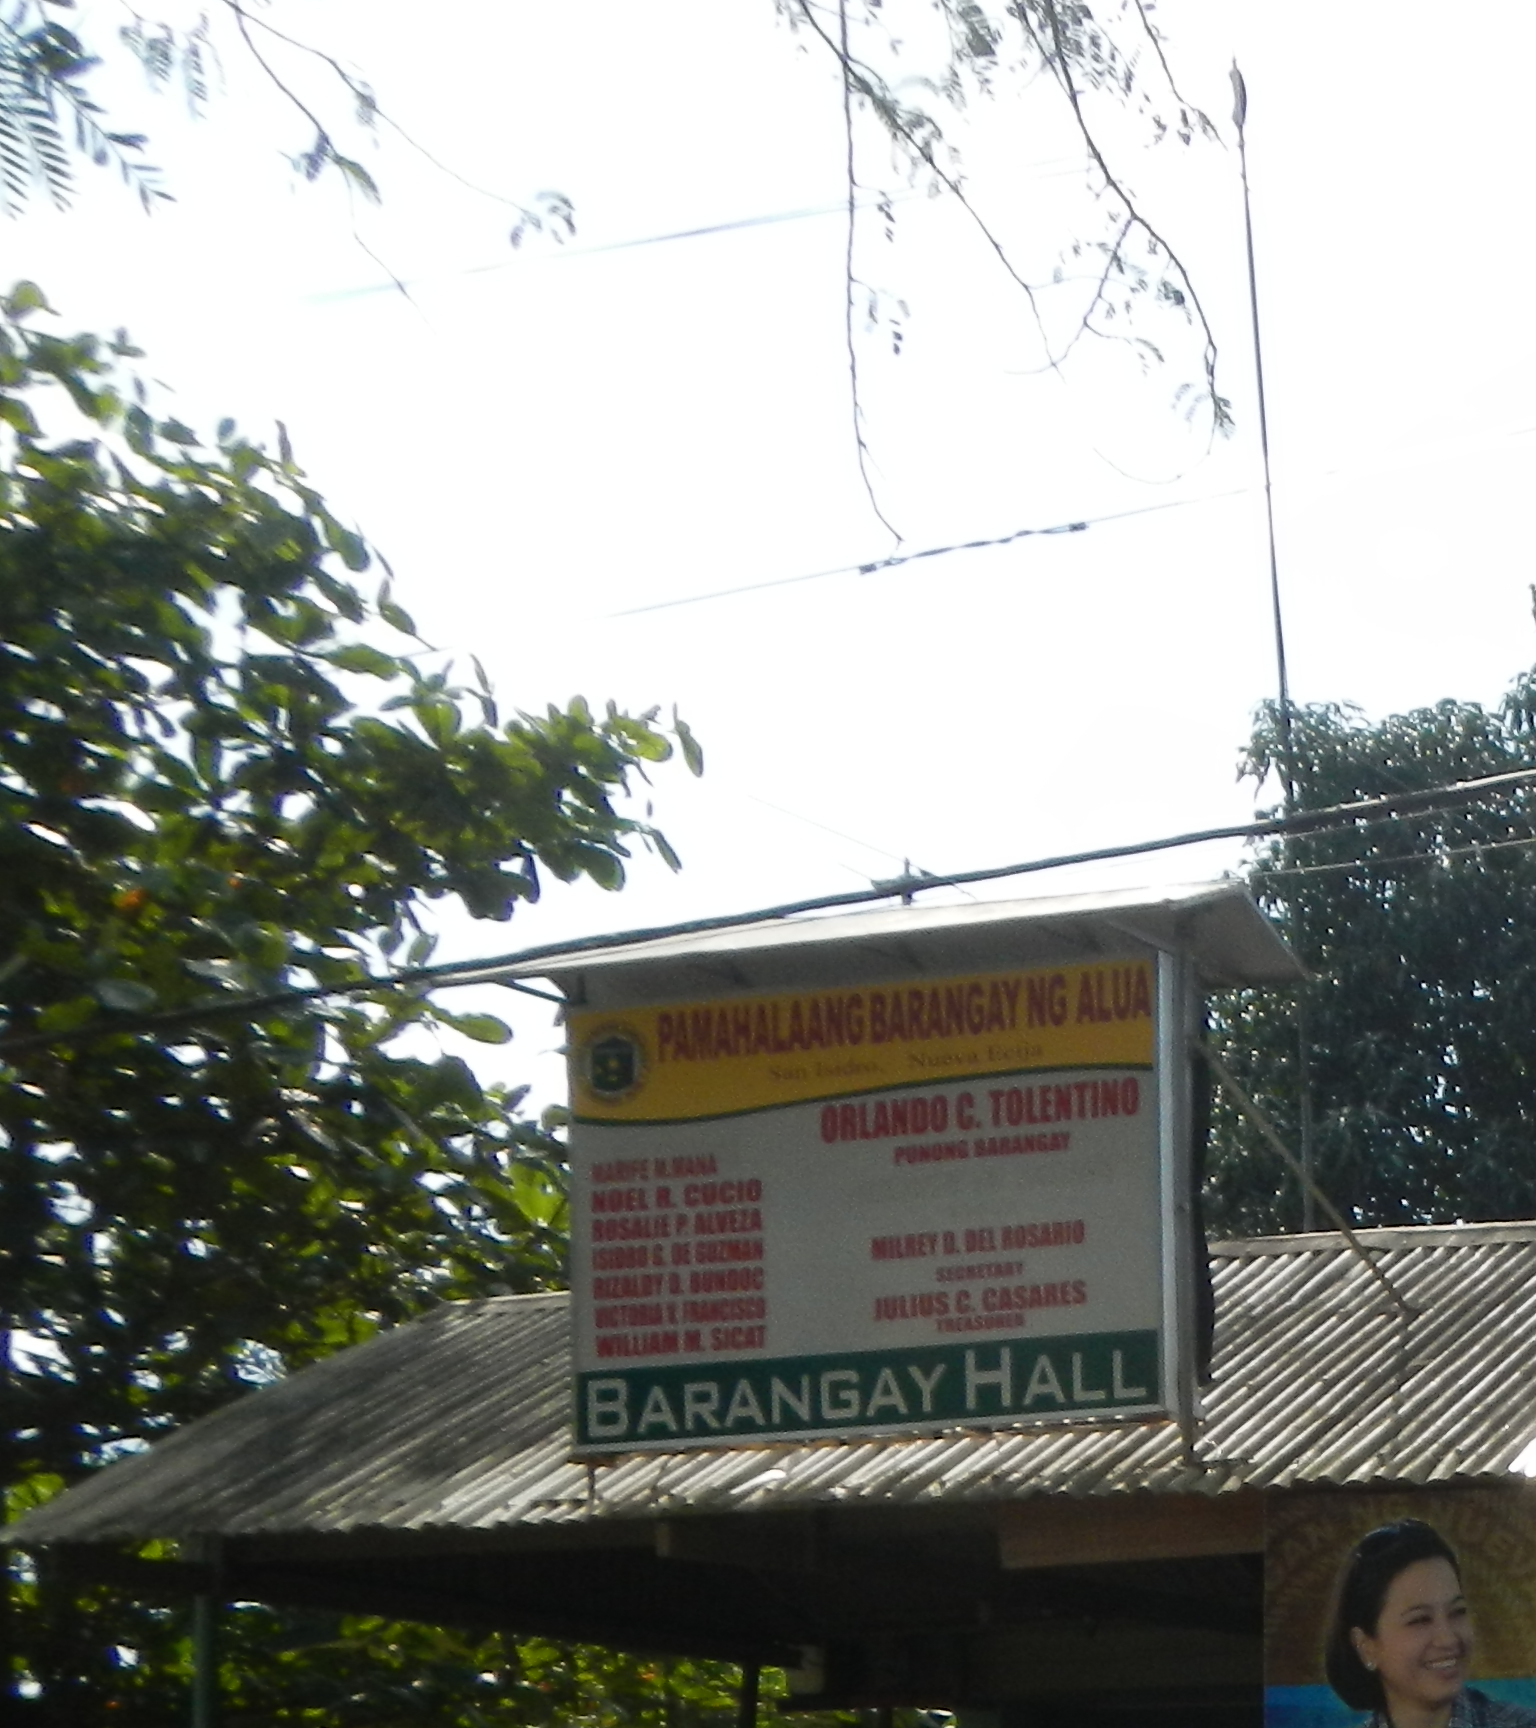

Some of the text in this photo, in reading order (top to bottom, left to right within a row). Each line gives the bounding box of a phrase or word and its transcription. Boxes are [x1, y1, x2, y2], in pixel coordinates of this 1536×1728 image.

[656, 967, 1151, 1063] PAMAHALAANG BARANGAY NG ALUA
[767, 1063, 808, 1082] San
[907, 1049, 979, 1070] Nueva
[820, 1076, 1140, 1145] ORLANDO C. TOLENTINO
[894, 1132, 1071, 1166] PUNONG BARANGAY
[591, 1187, 649, 1213] NOEL
[683, 1178, 762, 1207] CUCIO
[963, 1228, 997, 1253] DEL
[1001, 1219, 1086, 1250] ROSARIO
[936, 1261, 1023, 1282] SECRETARY
[874, 1279, 1087, 1322] JULIUS C. CASARES
[710, 1324, 767, 1352] SICAT
[936, 1313, 1025, 1334] TREASURER
[585, 1345, 1148, 1440] BARANGAY HALL
